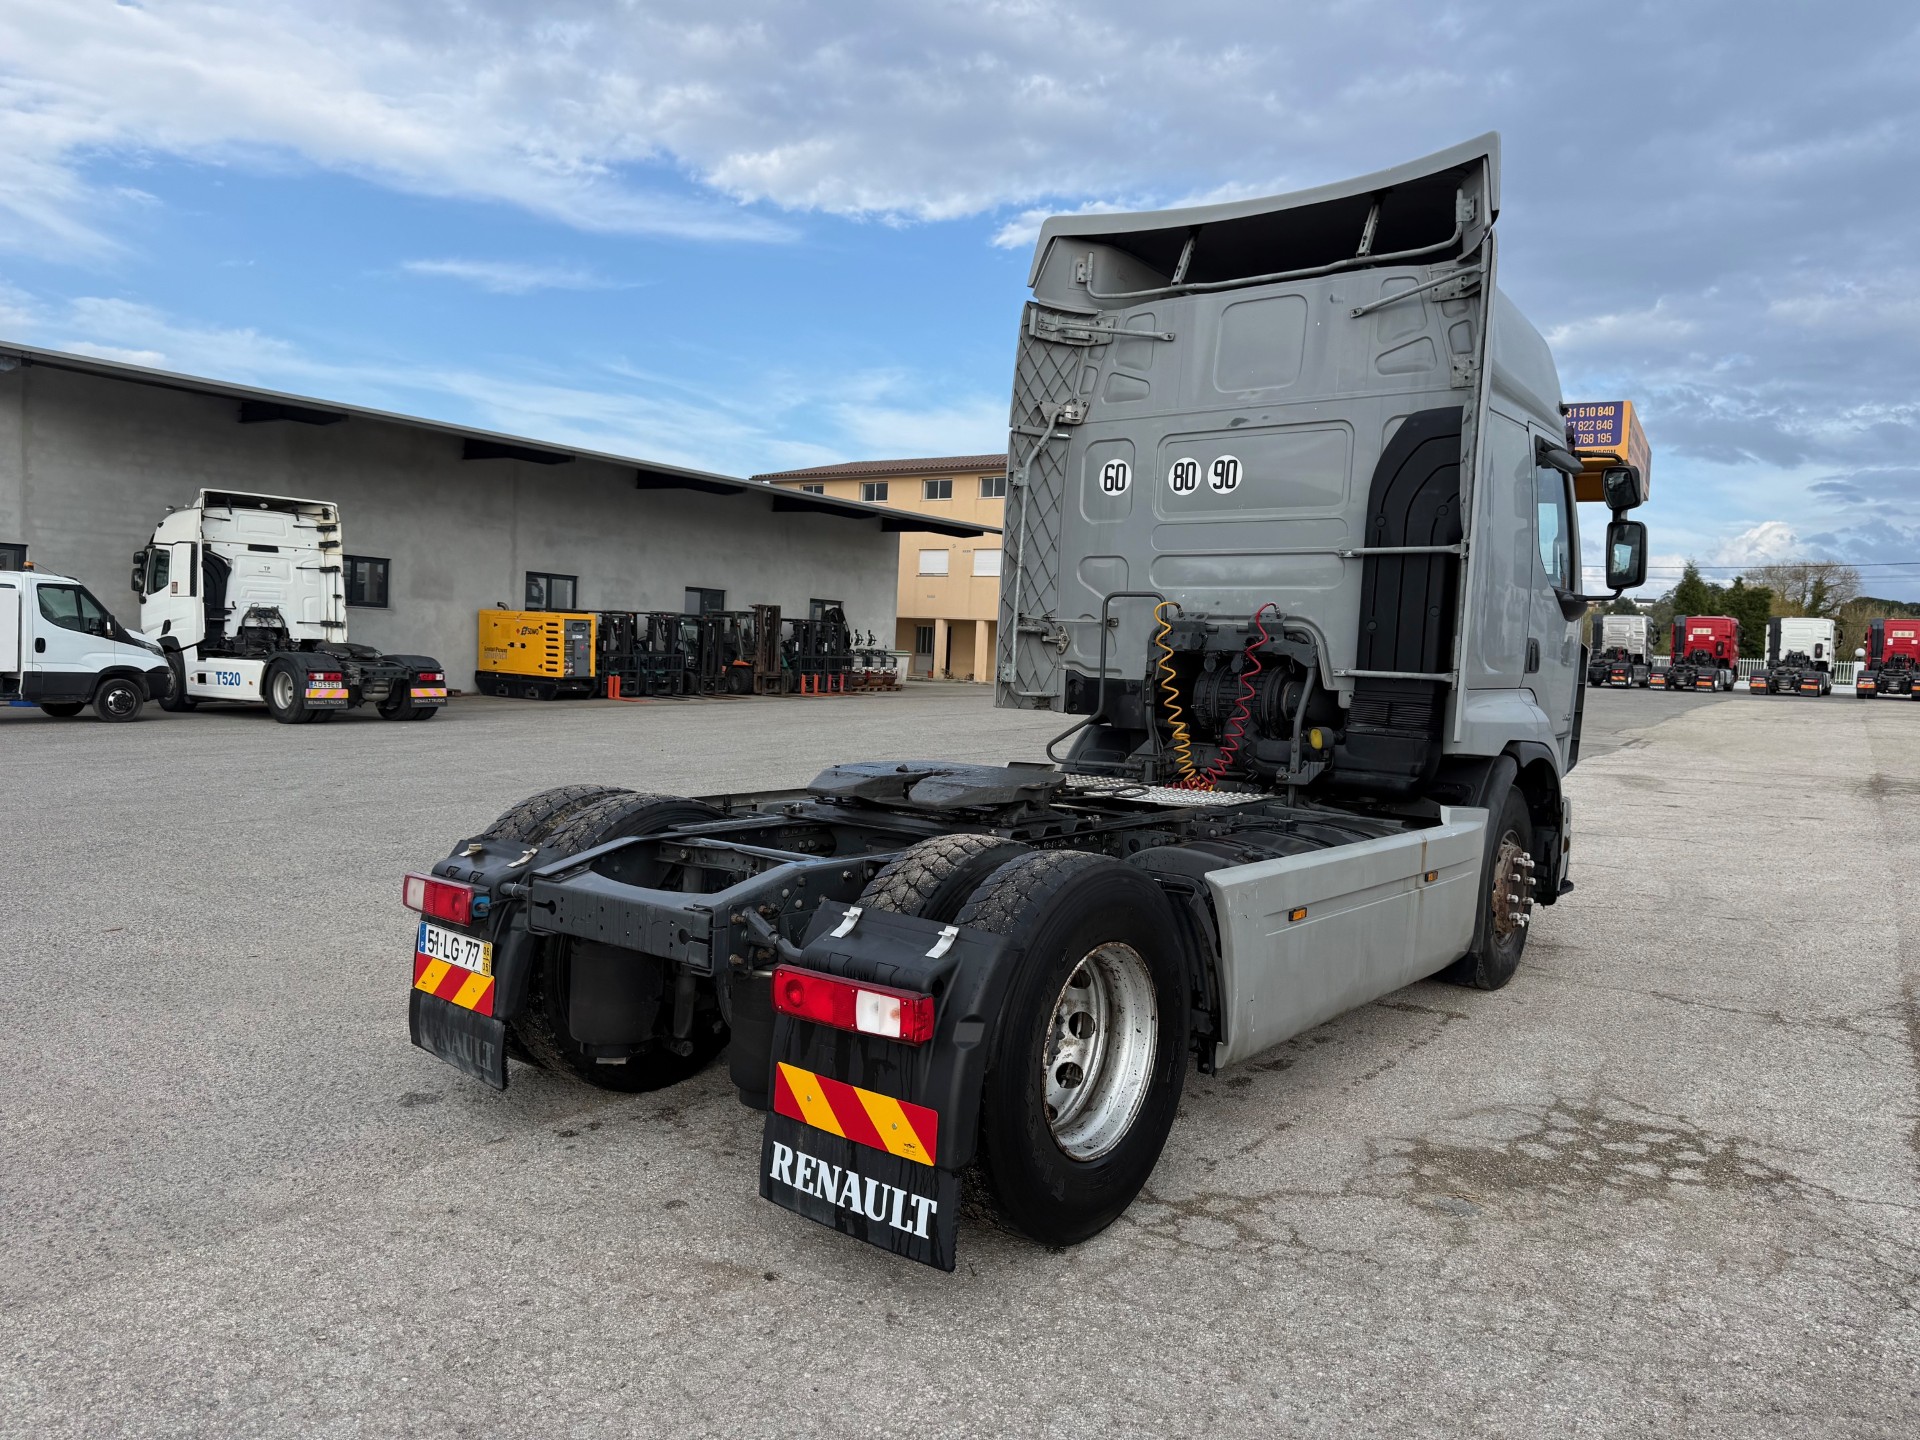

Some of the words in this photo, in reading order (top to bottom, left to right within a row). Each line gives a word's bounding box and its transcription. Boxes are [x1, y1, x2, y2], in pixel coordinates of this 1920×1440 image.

[1579, 406, 1596, 418] 510
[1597, 405, 1615, 417] 840
[1578, 420, 1594, 431] 822
[1596, 419, 1613, 430] 846
[1578, 433, 1594, 444] 768
[1597, 432, 1612, 444] 195
[1103, 463, 1127, 492] 60
[1173, 461, 1197, 492] 80
[1212, 459, 1238, 490] 90
[215, 671, 241, 687] T520
[769, 1140, 938, 1240] RENAULT
